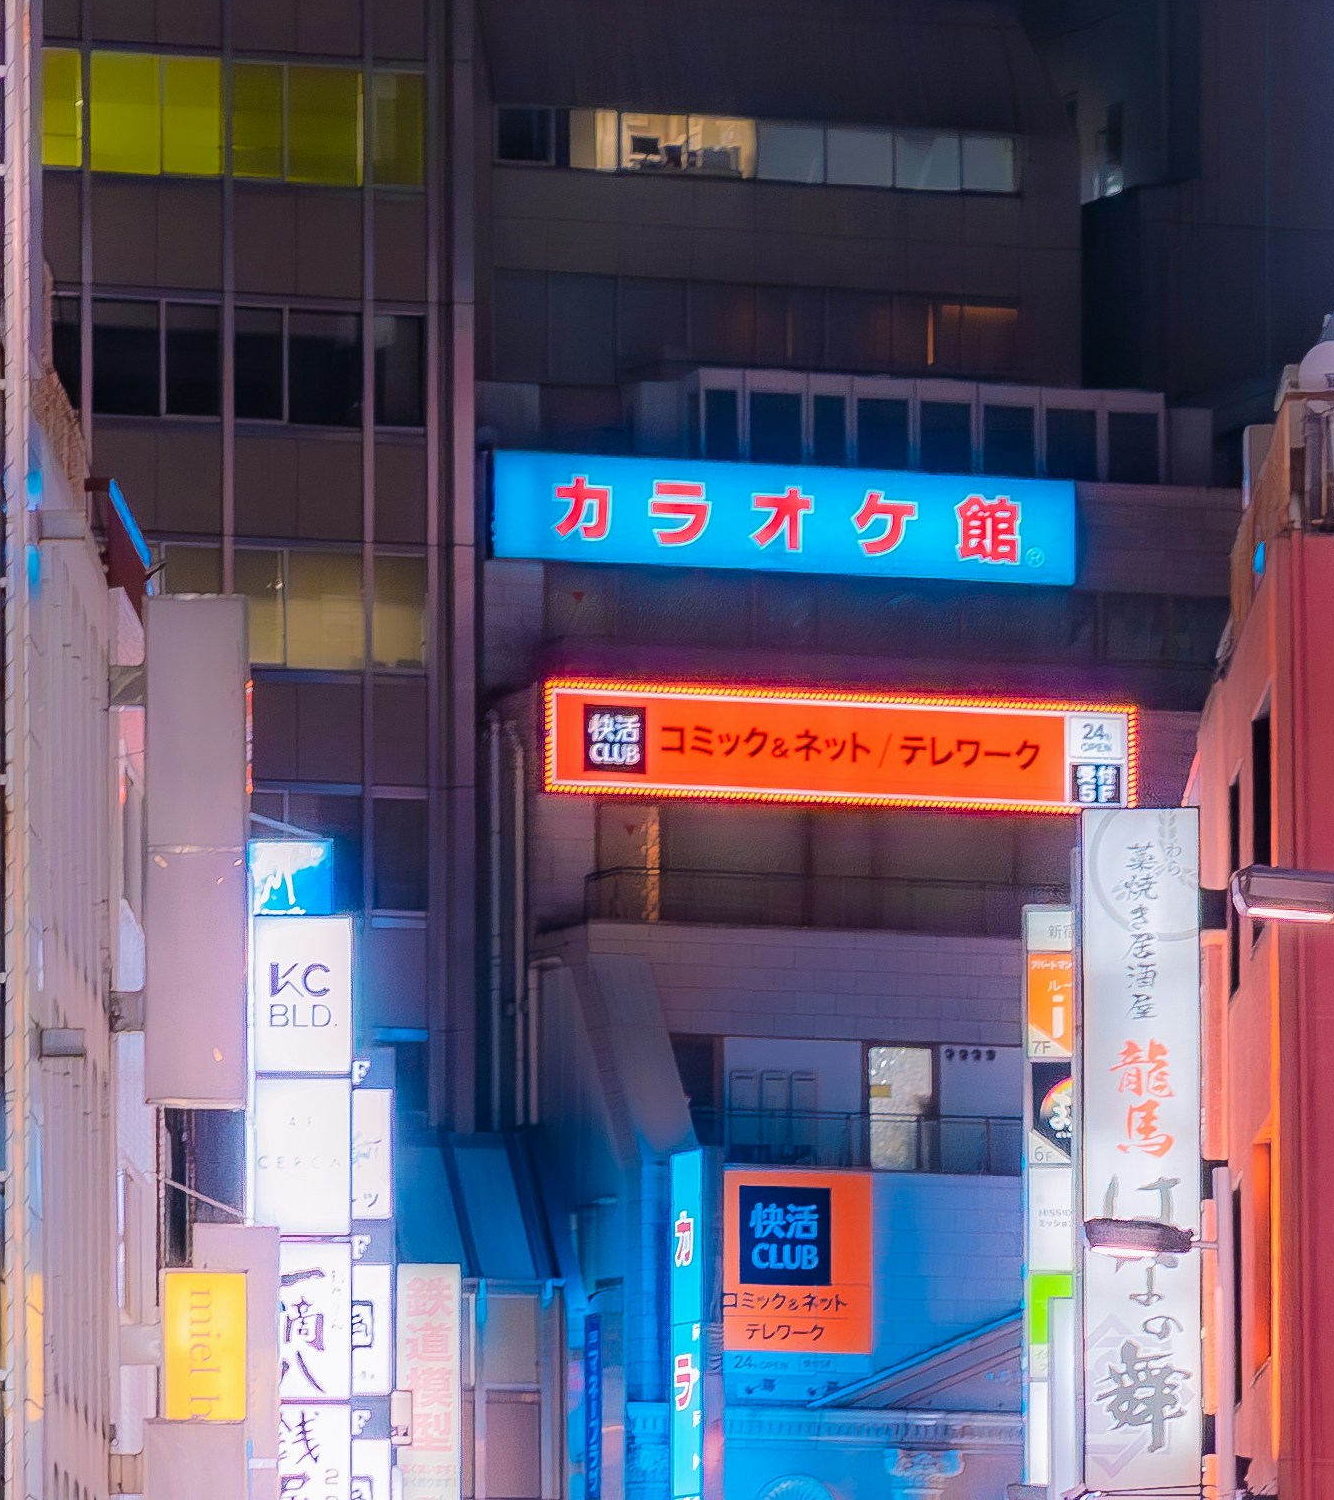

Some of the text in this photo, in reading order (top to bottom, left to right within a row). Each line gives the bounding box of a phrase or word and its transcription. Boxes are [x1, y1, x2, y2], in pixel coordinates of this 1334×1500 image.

[553, 474, 1023, 565] カラオケ館
[589, 712, 641, 743] 快活
[589, 741, 641, 766] CLUB
[1077, 784, 1117, 803] 5F
[269, 962, 331, 998] KC
[269, 1003, 338, 1029] BLD.
[1032, 1040, 1052, 1054] 7F
[1109, 1037, 1176, 1158] 龍馬
[1034, 1145, 1054, 1161] 6F
[750, 1202, 820, 1240] 快活
[751, 1242, 820, 1271] CLUB
[745, 1323, 826, 1342] テレワーク
[405, 1276, 455, 1454] 鉄道模型
